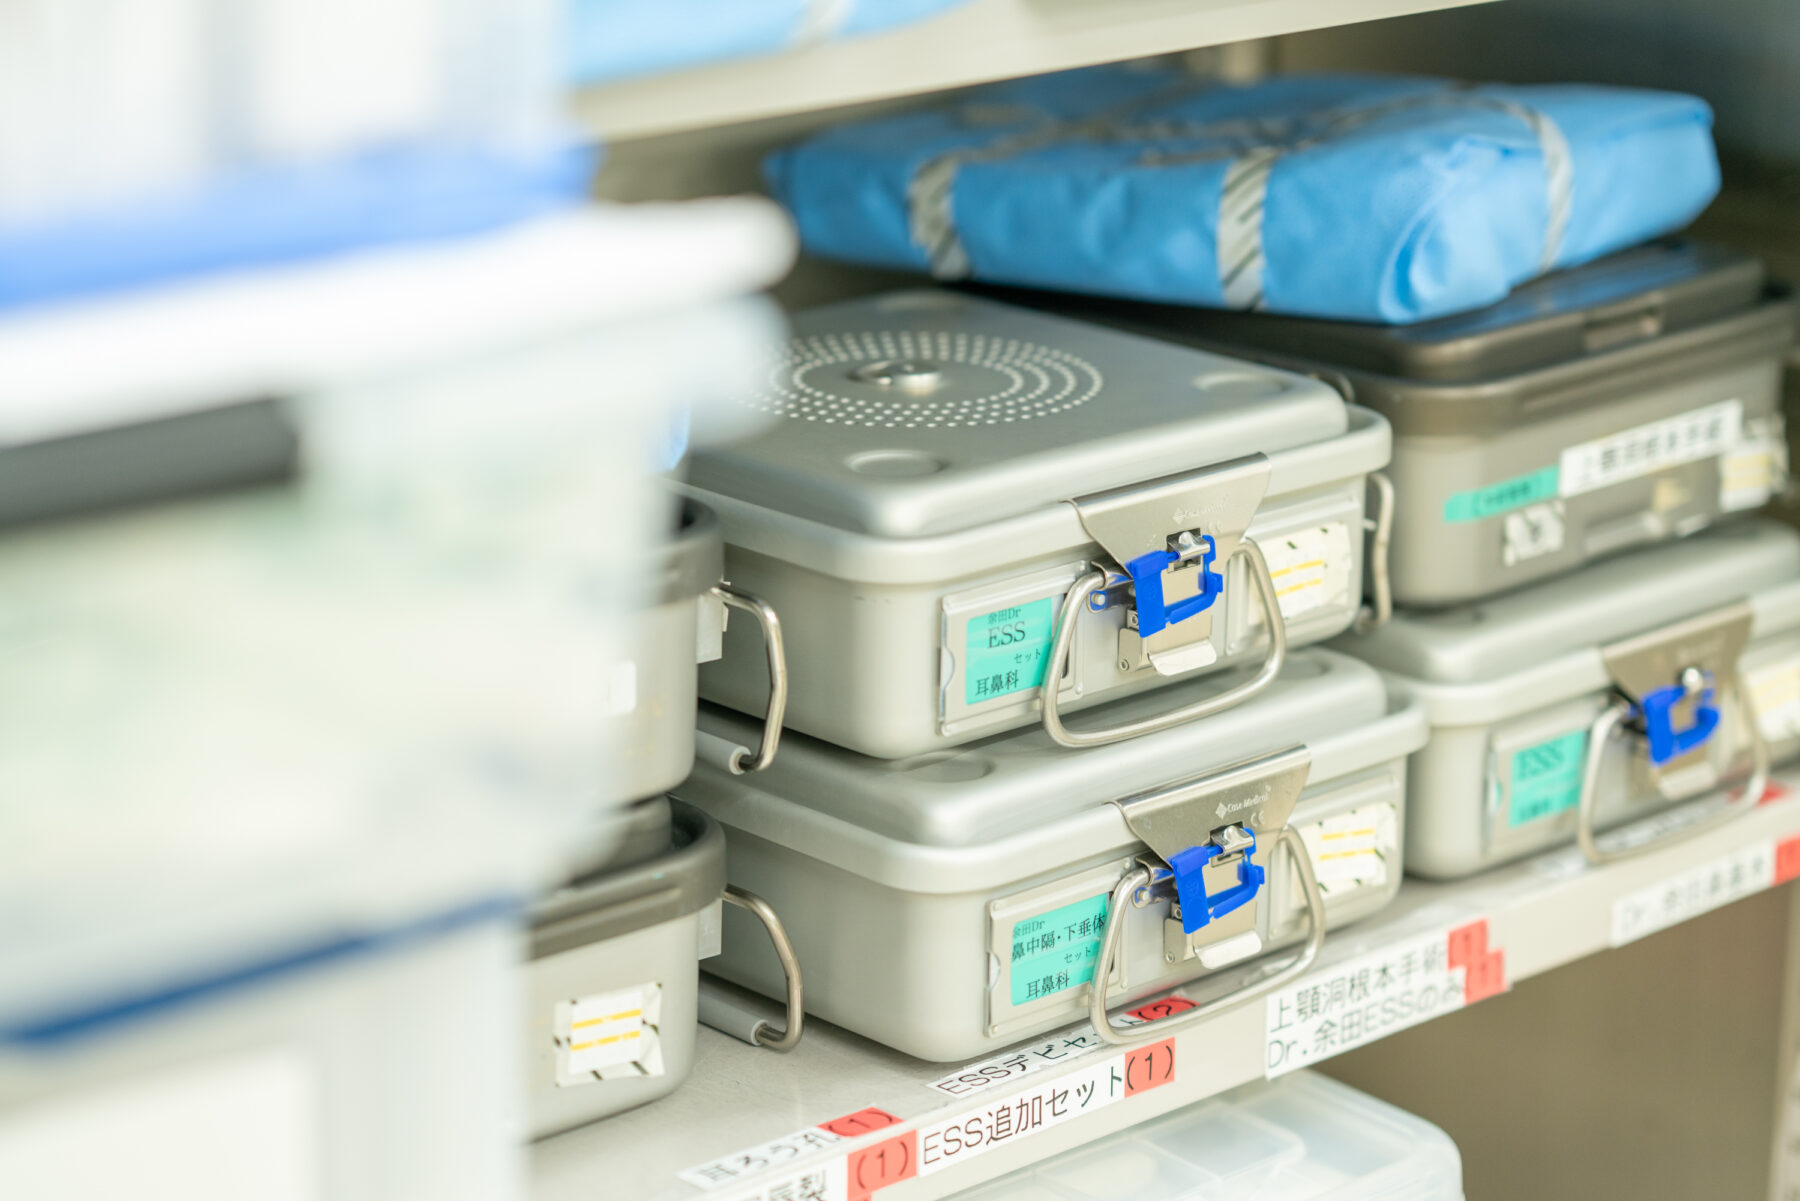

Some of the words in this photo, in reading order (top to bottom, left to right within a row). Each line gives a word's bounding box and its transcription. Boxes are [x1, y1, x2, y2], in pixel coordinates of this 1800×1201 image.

[987, 621, 1026, 649] ESS
[1014, 648, 1041, 664] セット
[975, 669, 1019, 696] 耳鼻科
[1227, 802, 1242, 813] Case
[1064, 946, 1092, 964] セット
[1026, 968, 1070, 999] 耳鼻科
